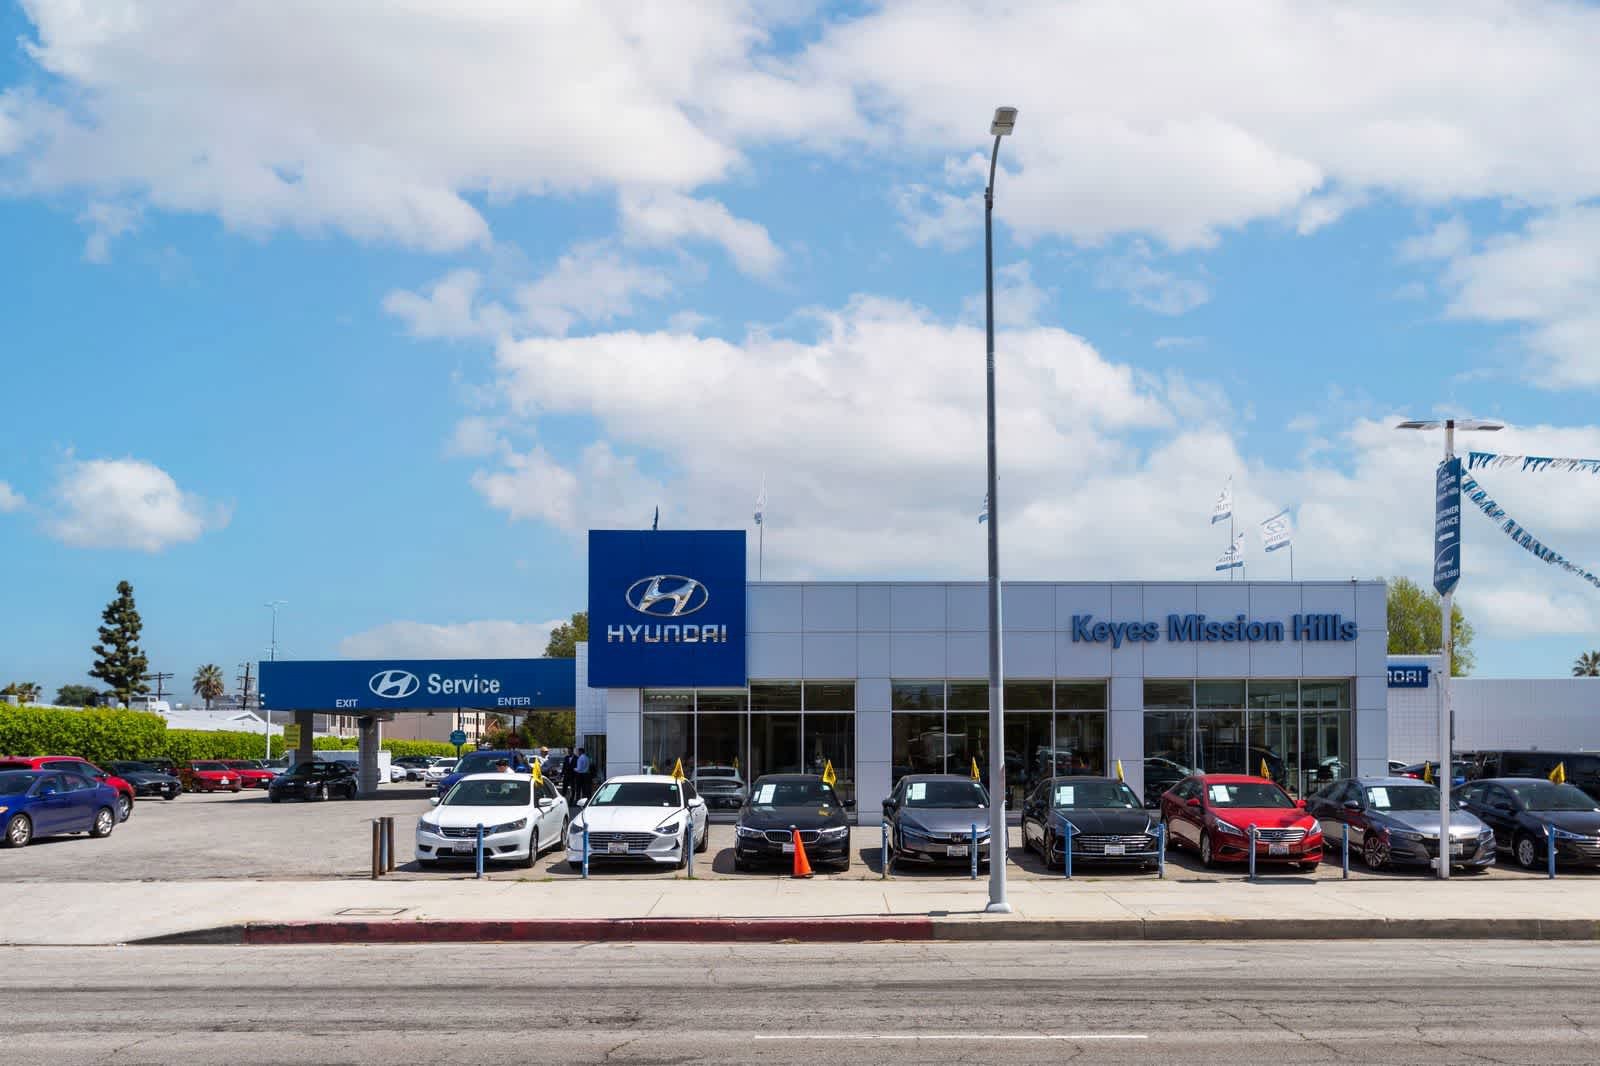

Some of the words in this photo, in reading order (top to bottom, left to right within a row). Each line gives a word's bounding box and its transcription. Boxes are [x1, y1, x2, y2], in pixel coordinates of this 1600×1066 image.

[607, 624, 727, 643] HYUNDAI
[1072, 614, 1158, 648] Keyes
[1168, 614, 1284, 642] Mission
[1293, 614, 1357, 642] Hills
[427, 673, 501, 695] Service
[335, 698, 359, 708] EXIT
[497, 697, 531, 706] ENTER
